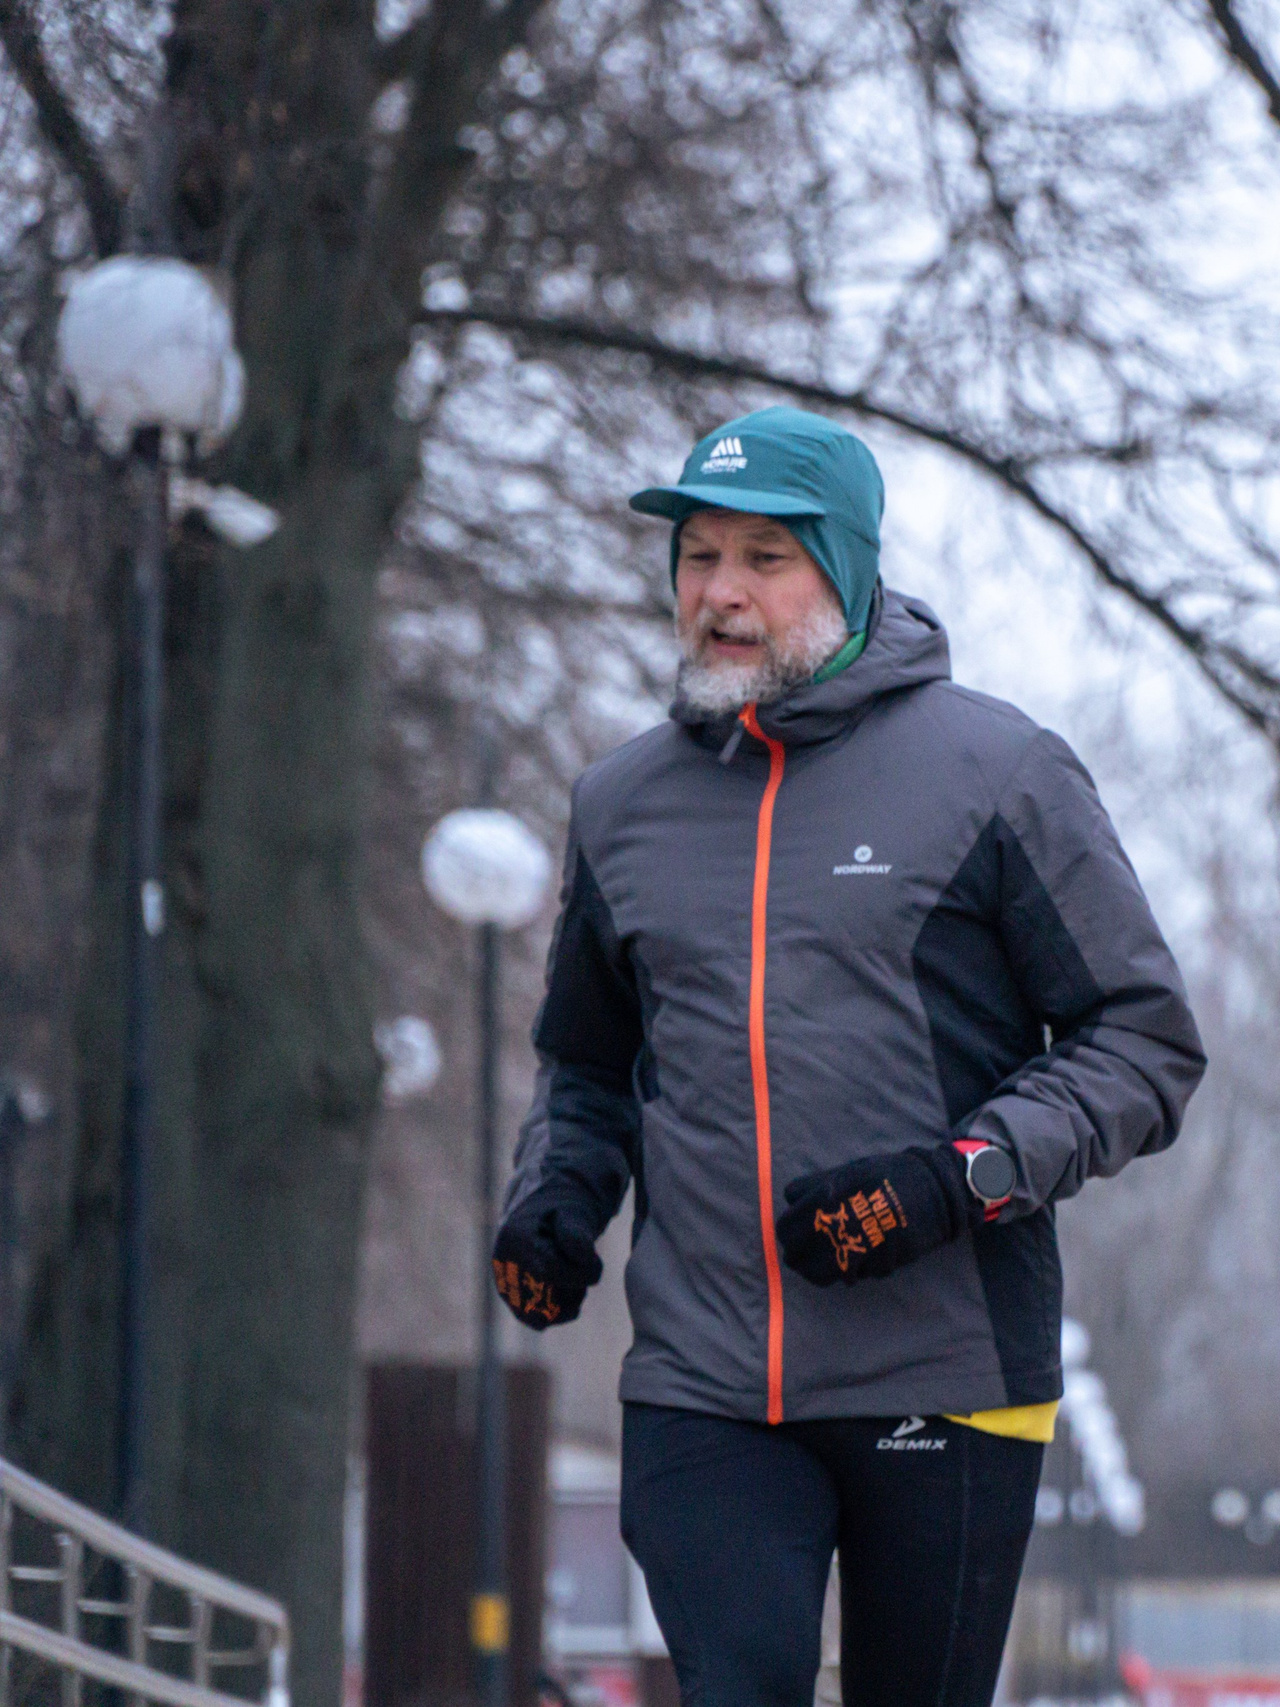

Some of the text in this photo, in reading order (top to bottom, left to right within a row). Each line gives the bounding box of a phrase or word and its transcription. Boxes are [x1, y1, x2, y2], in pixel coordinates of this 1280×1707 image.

[848, 1190, 885, 1248] MAD FOX
[868, 1188, 897, 1232] ULTRA
[876, 1438, 948, 1450] DEMIX
